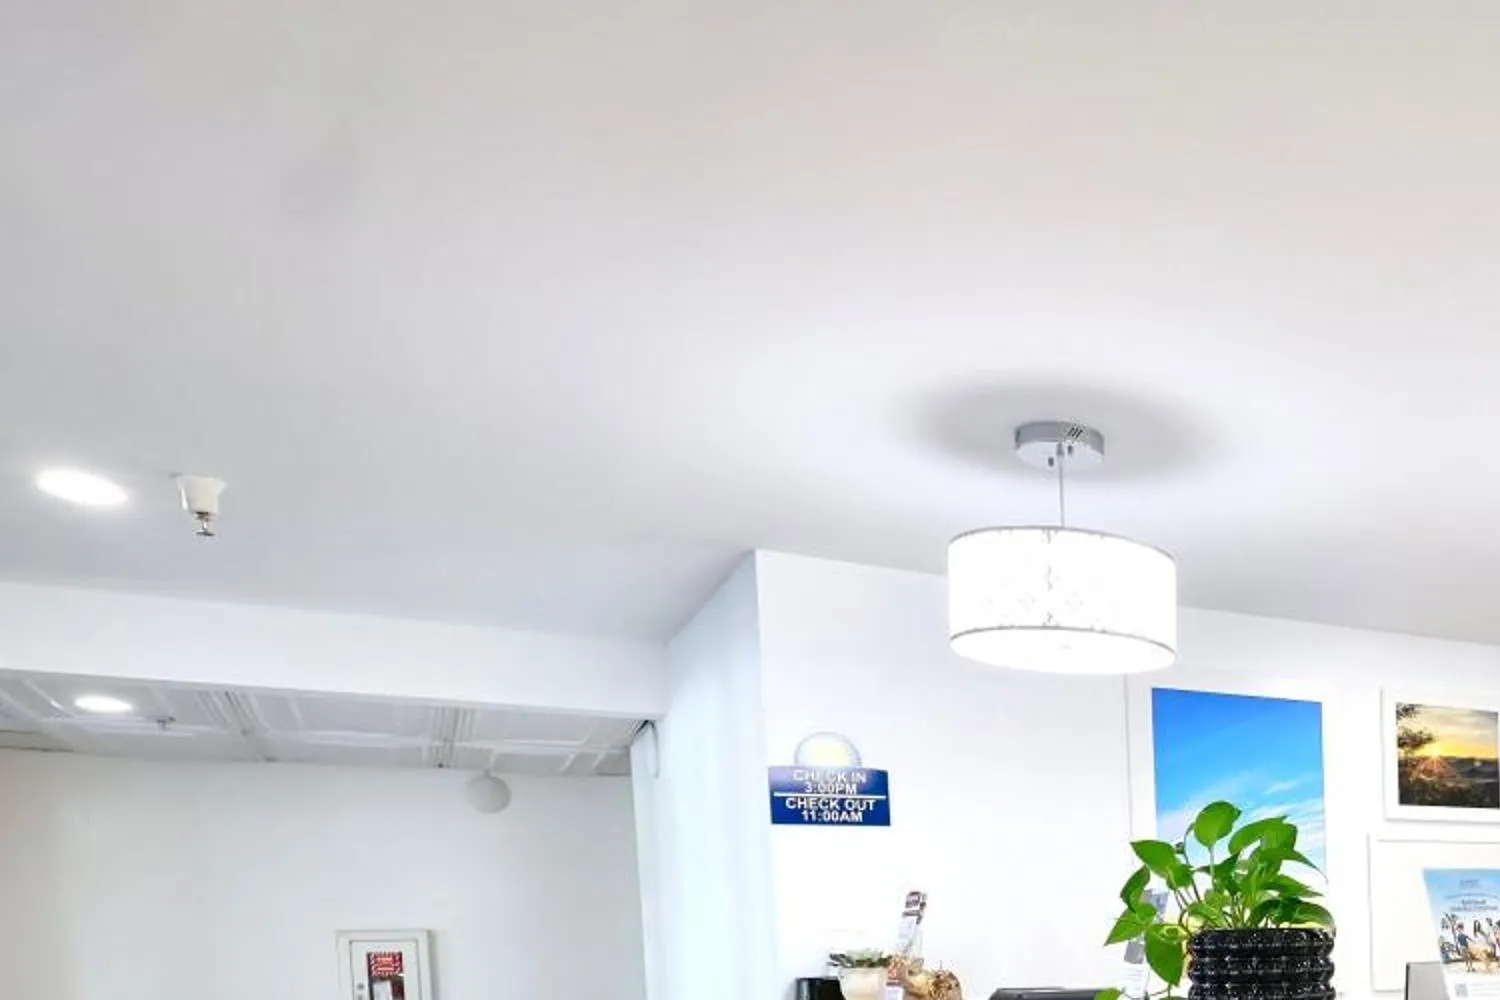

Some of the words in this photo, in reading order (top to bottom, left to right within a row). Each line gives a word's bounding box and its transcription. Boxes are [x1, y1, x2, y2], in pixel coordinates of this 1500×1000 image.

[851, 772, 867, 784] IN
[805, 781, 857, 795] 3:00PM
[785, 797, 841, 811] CHECK
[845, 799, 876, 811] OUT
[801, 810, 863, 823] 11:00AM
